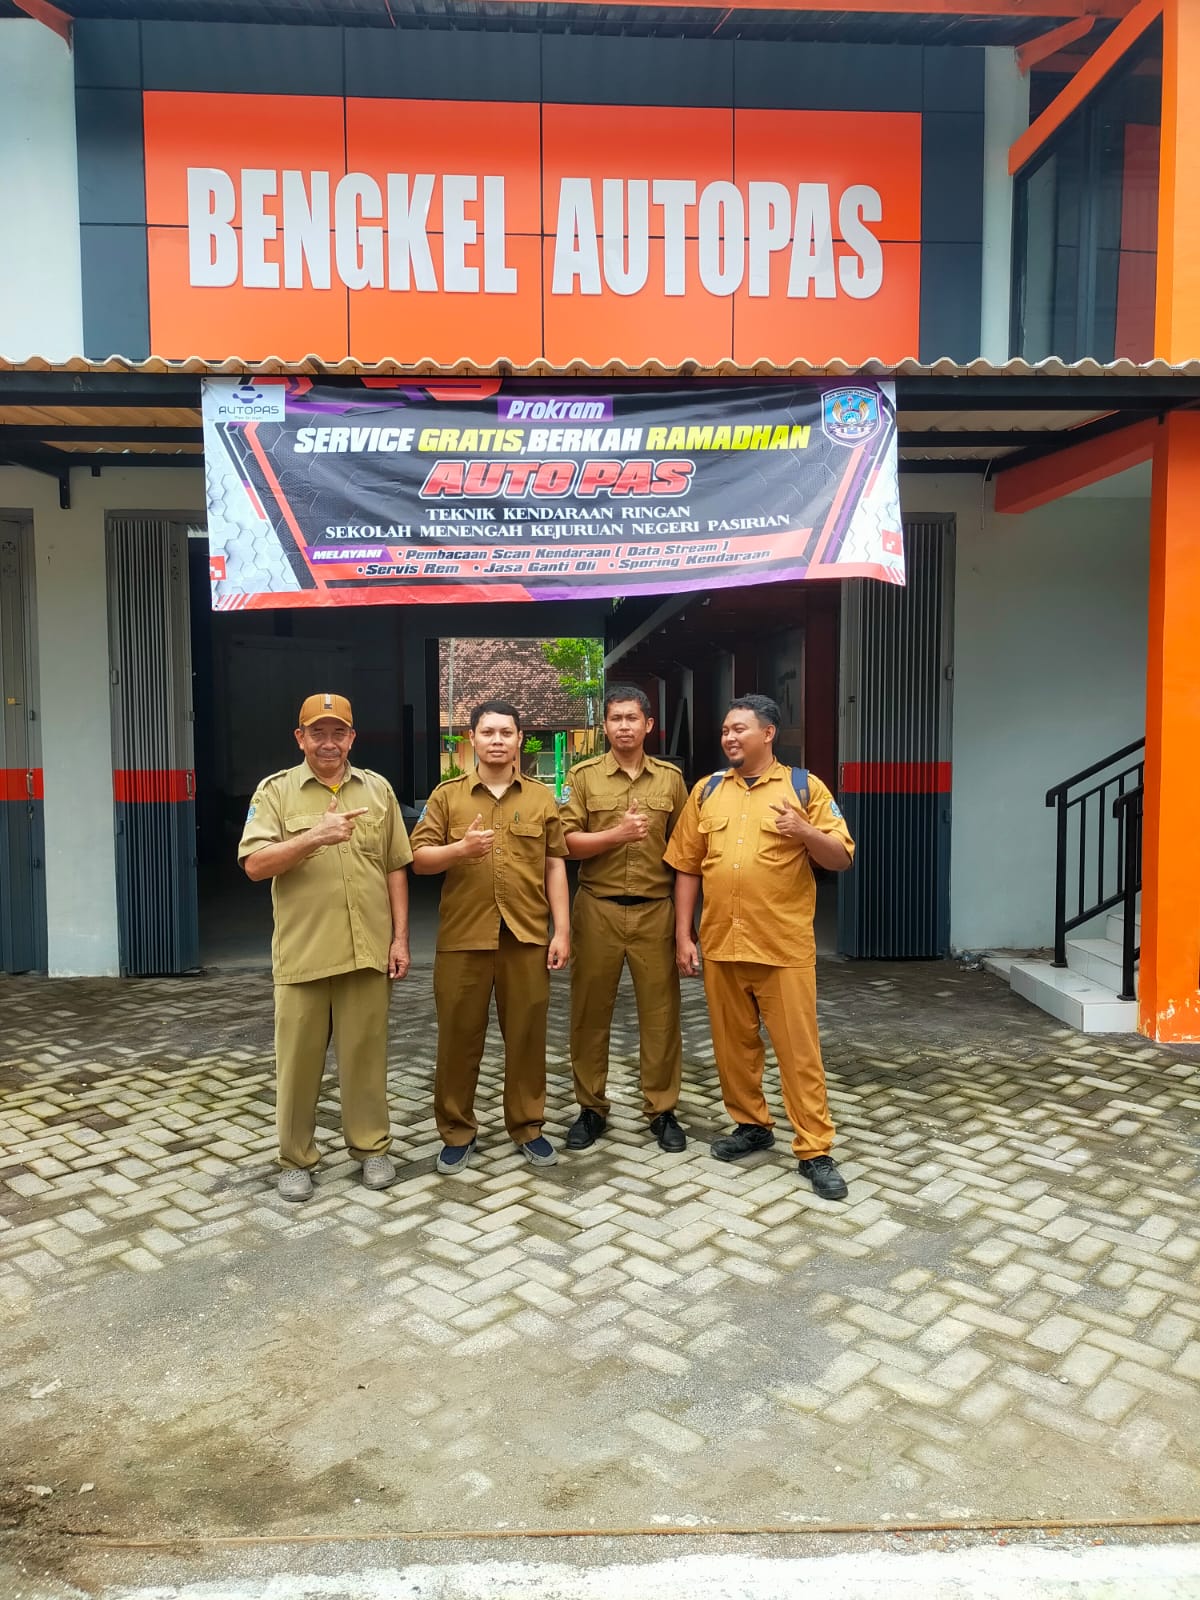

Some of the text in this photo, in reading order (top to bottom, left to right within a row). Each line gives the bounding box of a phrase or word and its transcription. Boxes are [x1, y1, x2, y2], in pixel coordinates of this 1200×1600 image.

[187, 167, 883, 299] BENGKEL AUTOPAS
[218, 405, 279, 415] AUTOPAS
[506, 399, 605, 420] Prokram
[293, 427, 415, 453] SERVICE
[646, 425, 811, 450] RAMADHAN
[418, 459, 696, 499] AUTO PAS
[425, 506, 691, 521] TEKNIK KENDARAAN RINGAN
[325, 514, 790, 540] SEKOLAH MENENGAH KEJURUAN NEGERI PASIRIAN
[312, 549, 383, 560] MELAYANI
[365, 550, 772, 576] Servis Rem Jasa Ganti Oli Sporing Kendaraan
[405, 549, 488, 560] Pembacaan
[492, 549, 531, 560] Scan
[534, 548, 611, 559] Kendaraan
[627, 546, 660, 557] Data
[664, 543, 718, 555] Stream
